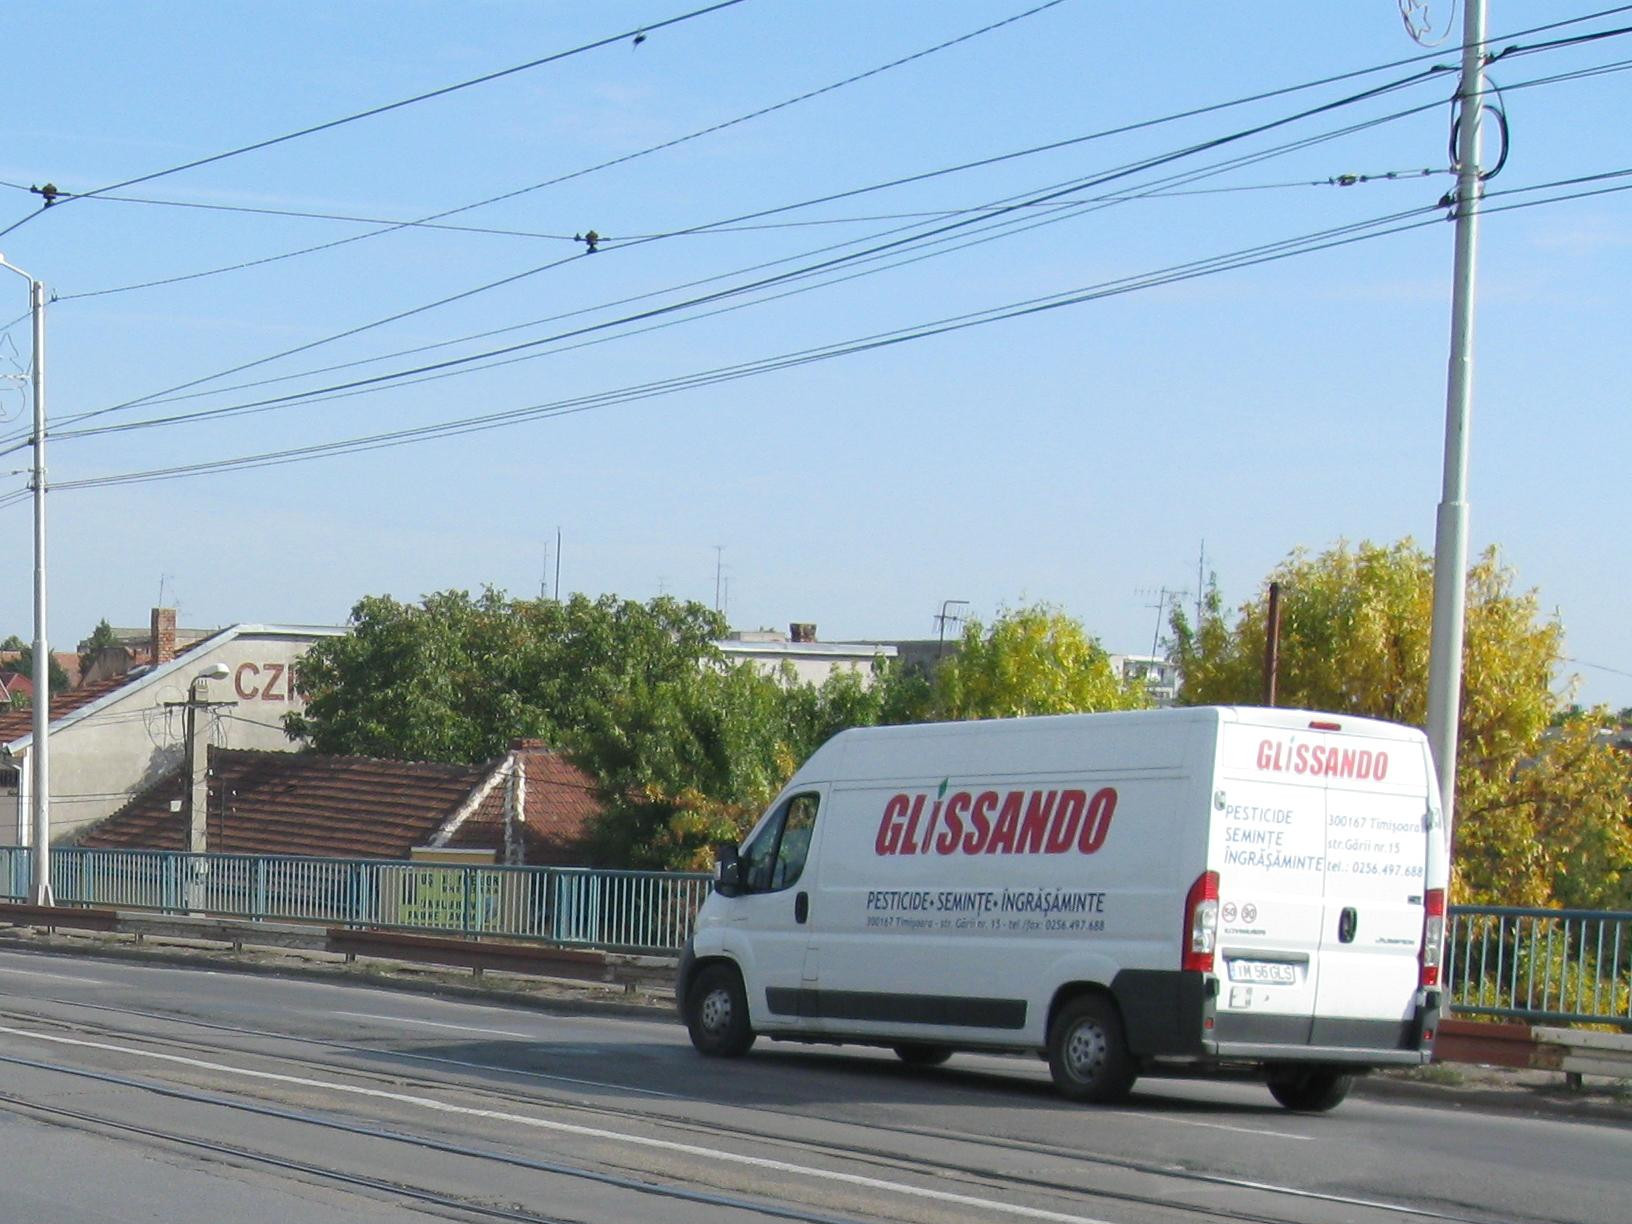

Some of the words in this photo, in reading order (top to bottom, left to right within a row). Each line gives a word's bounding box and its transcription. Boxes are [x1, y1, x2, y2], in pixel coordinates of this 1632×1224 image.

[1225, 805, 1293, 825] PESTICIDE
[1328, 815, 1367, 829] 300167
[866, 891, 930, 911] PESTICIDE
